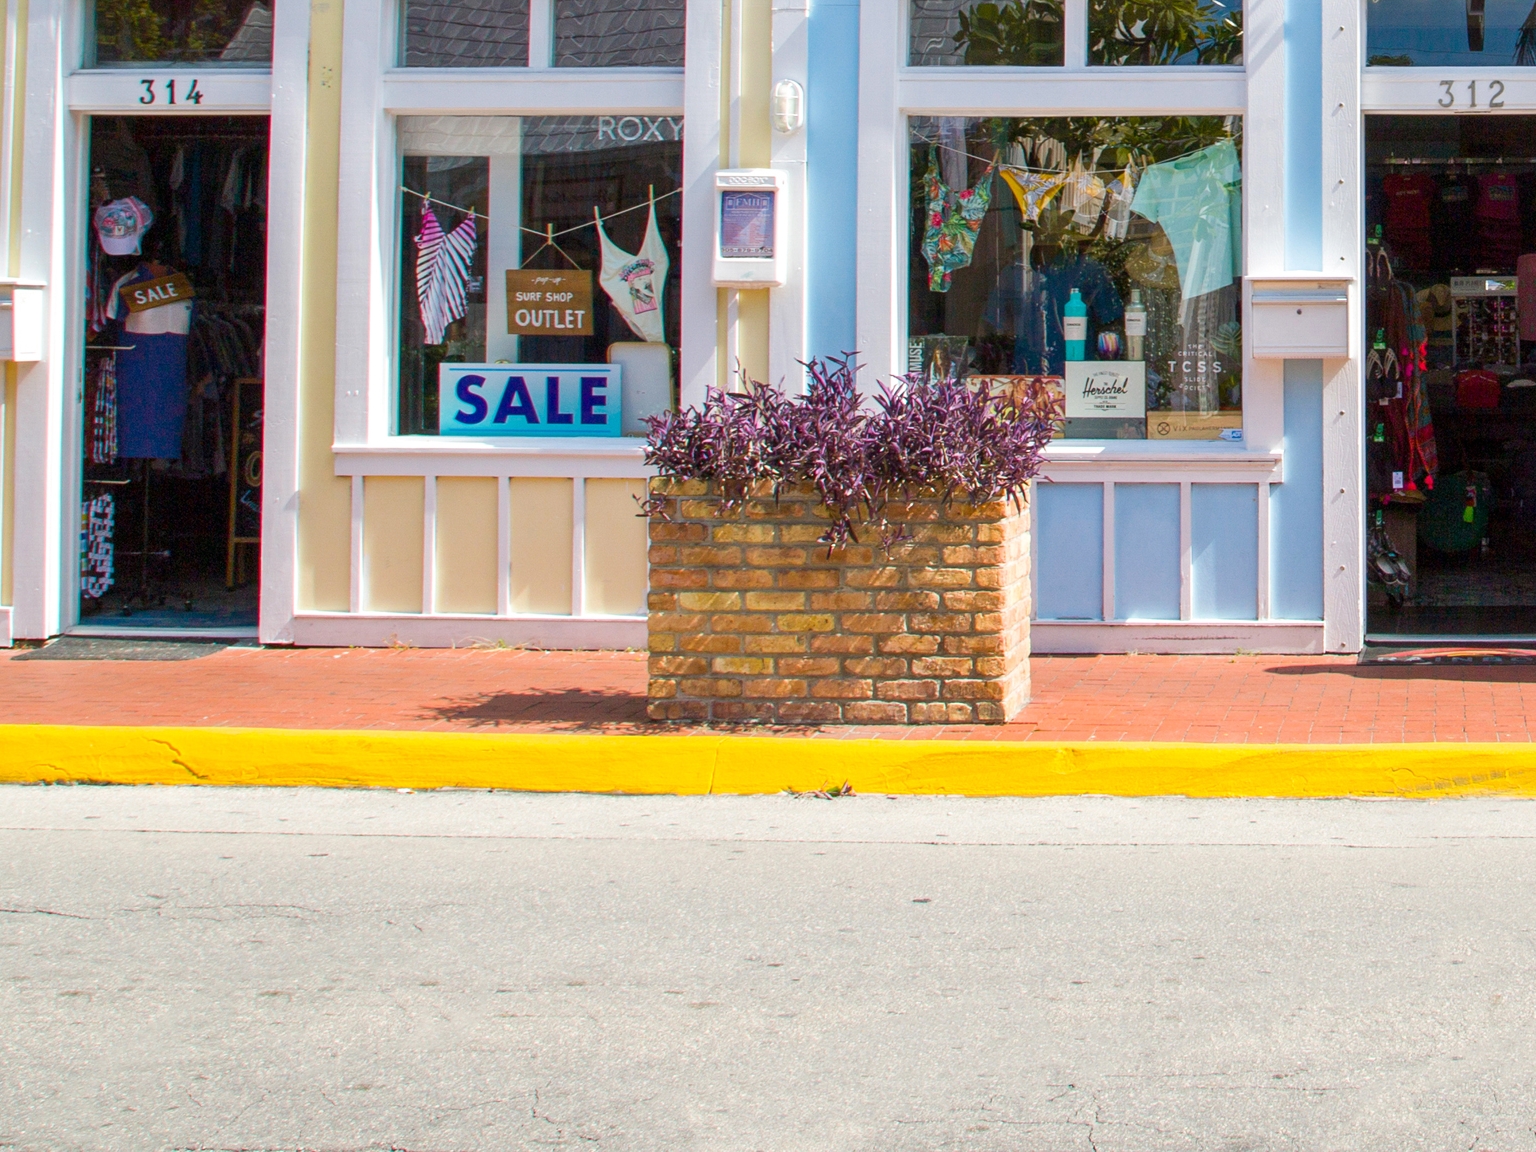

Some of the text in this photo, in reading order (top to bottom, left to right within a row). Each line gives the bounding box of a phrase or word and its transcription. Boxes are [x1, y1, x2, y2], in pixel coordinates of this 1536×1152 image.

[140, 79, 204, 105] 314
[1438, 80, 1505, 108] 312
[598, 116, 684, 141] ROXY
[135, 282, 179, 305] SALE
[516, 292, 574, 303] SURF SHOP
[515, 309, 585, 329] OUTLET
[909, 342, 923, 372] MUSE
[454, 374, 608, 425] SALE
[1082, 377, 1128, 399] Herschel
